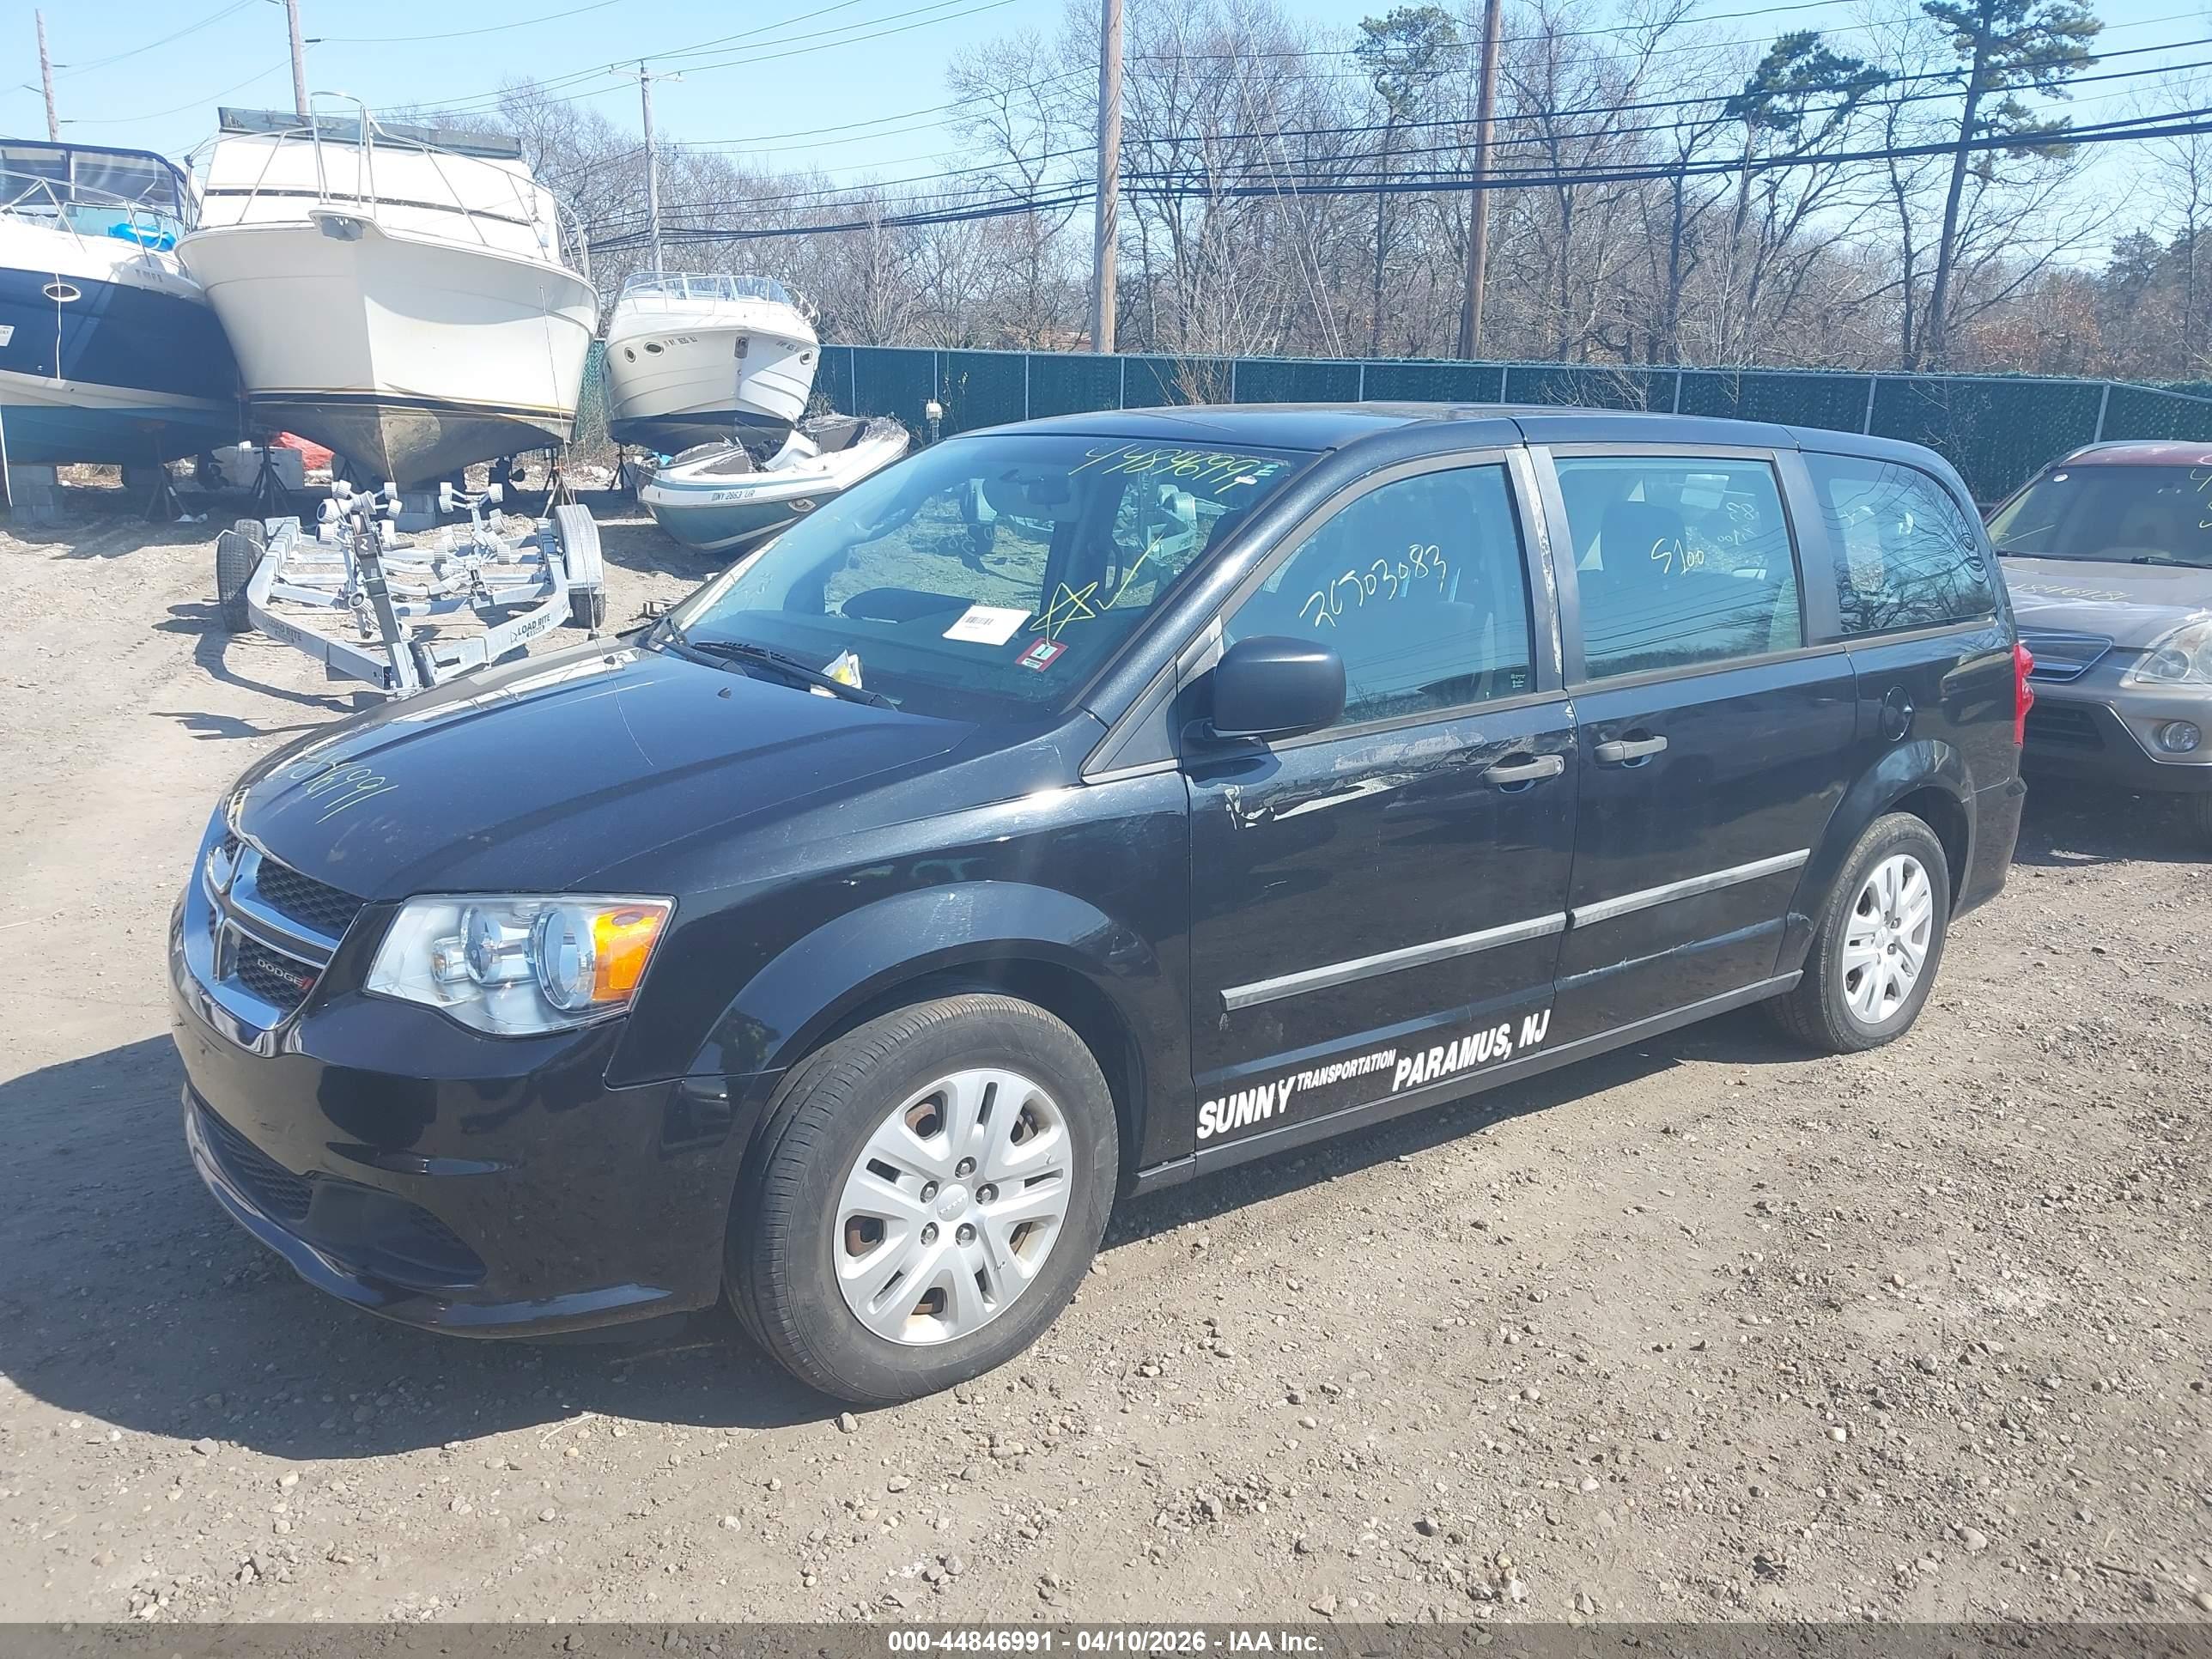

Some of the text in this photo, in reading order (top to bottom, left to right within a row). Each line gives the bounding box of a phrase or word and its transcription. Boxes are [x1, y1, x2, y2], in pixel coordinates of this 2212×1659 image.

[268, 617, 284, 633] LOAD
[286, 627, 302, 641] RITE
[518, 620, 536, 635] LOAD
[538, 613, 550, 626] RITE
[257, 958, 304, 988] DODGE
[1196, 1009, 1552, 1139] SUNNY TRANSPORTATION PARAMUS, NJ
